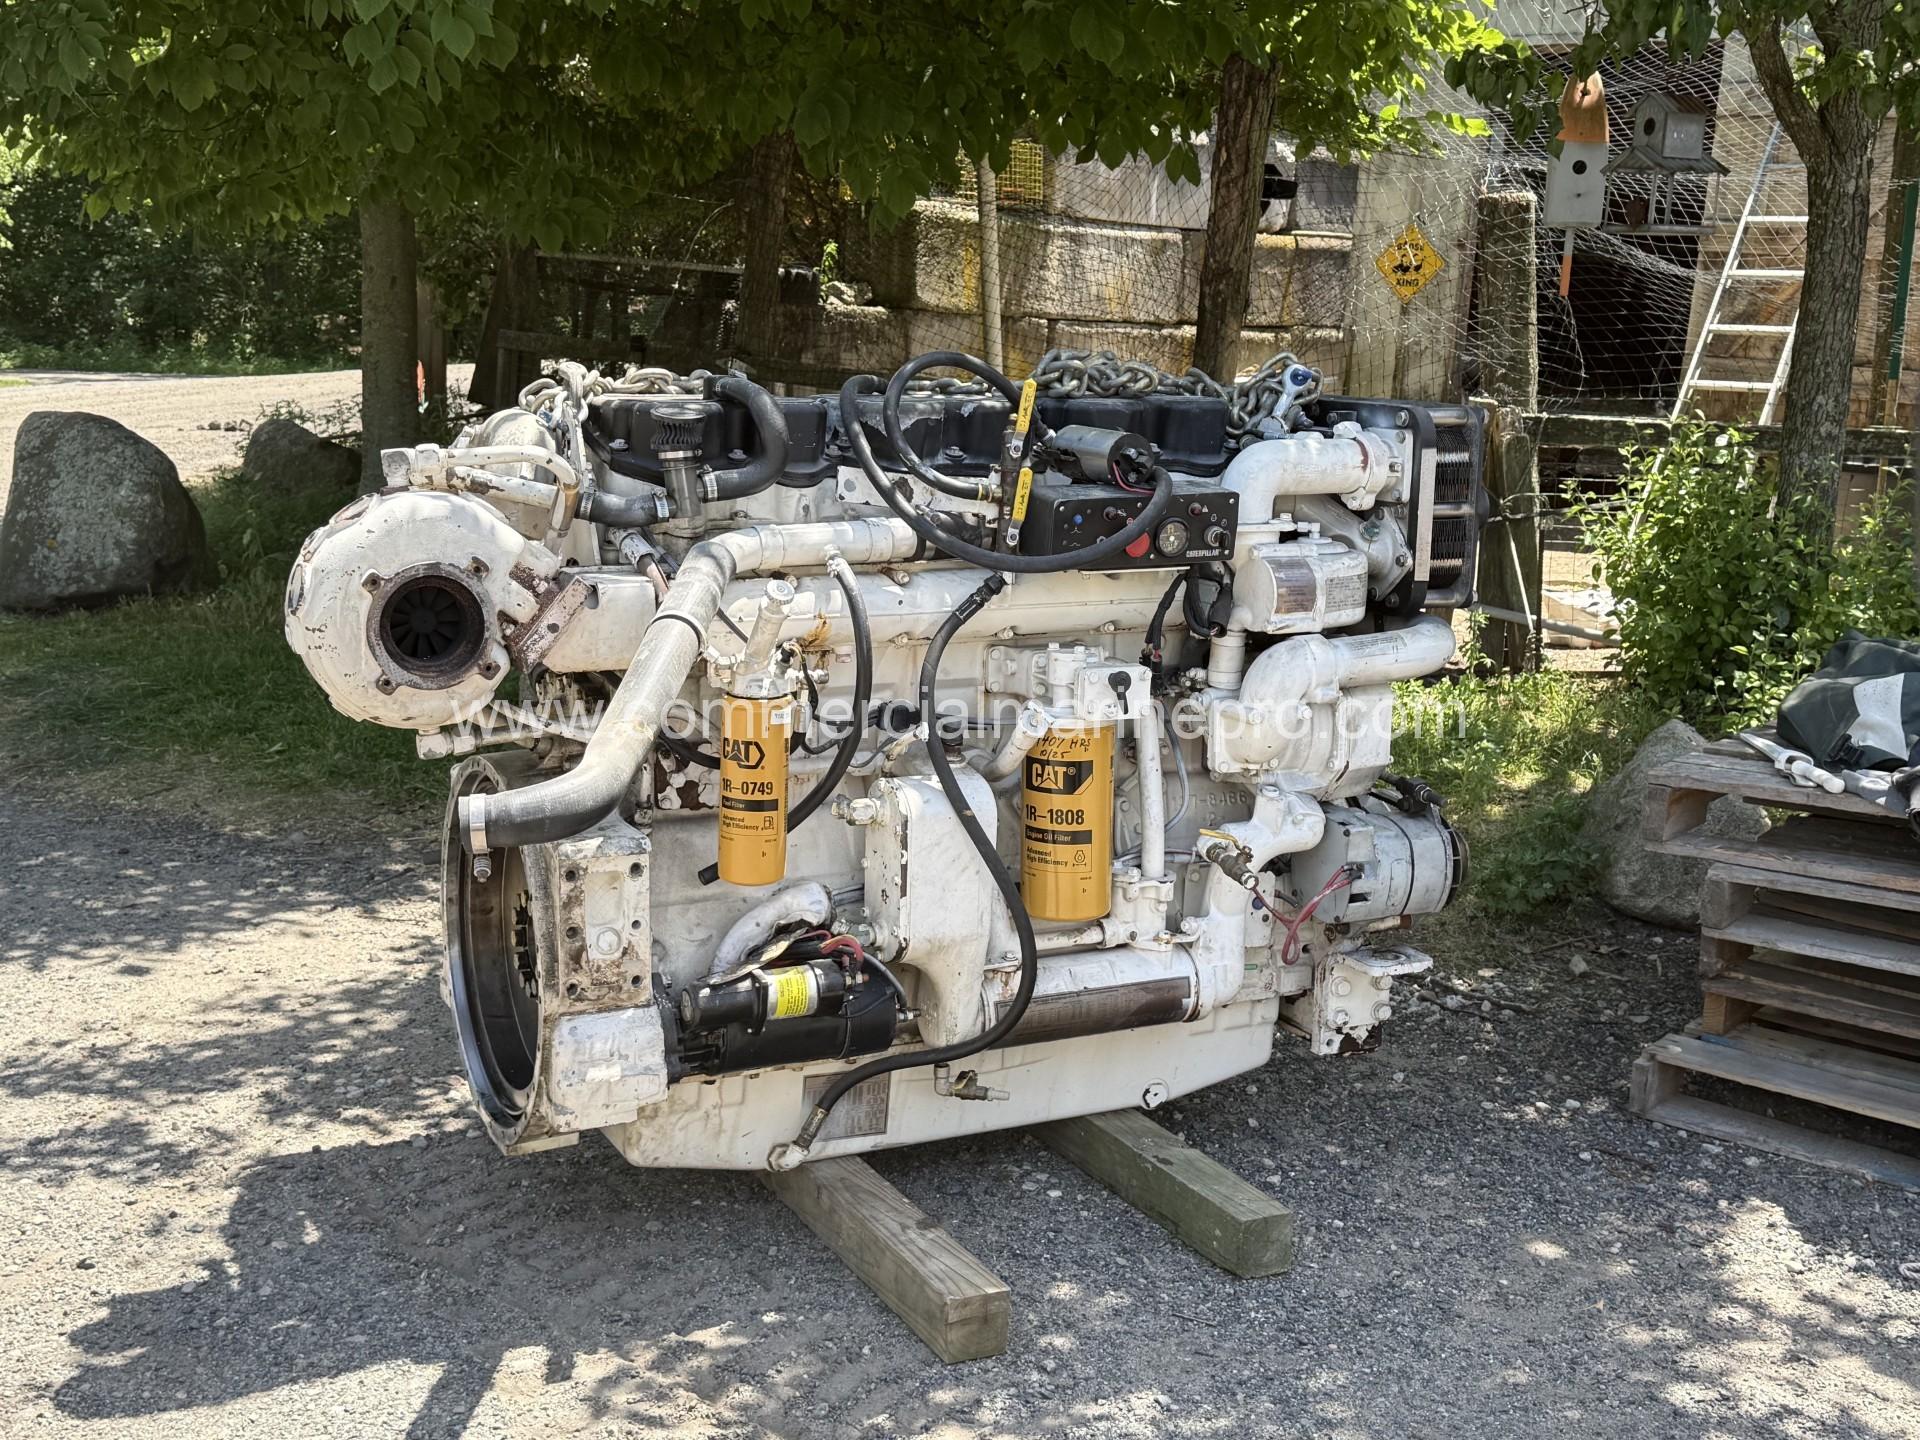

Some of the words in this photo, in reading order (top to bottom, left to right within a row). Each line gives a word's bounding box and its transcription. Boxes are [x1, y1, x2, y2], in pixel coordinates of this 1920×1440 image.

[722, 736, 755, 765] CAT
[722, 777, 774, 796] 1R-0749
[1025, 803, 1085, 826] 1R-1808
[732, 822, 760, 832] Efficiency
[1054, 833, 1072, 842] Filter
[1037, 856, 1069, 868] Efficiency
